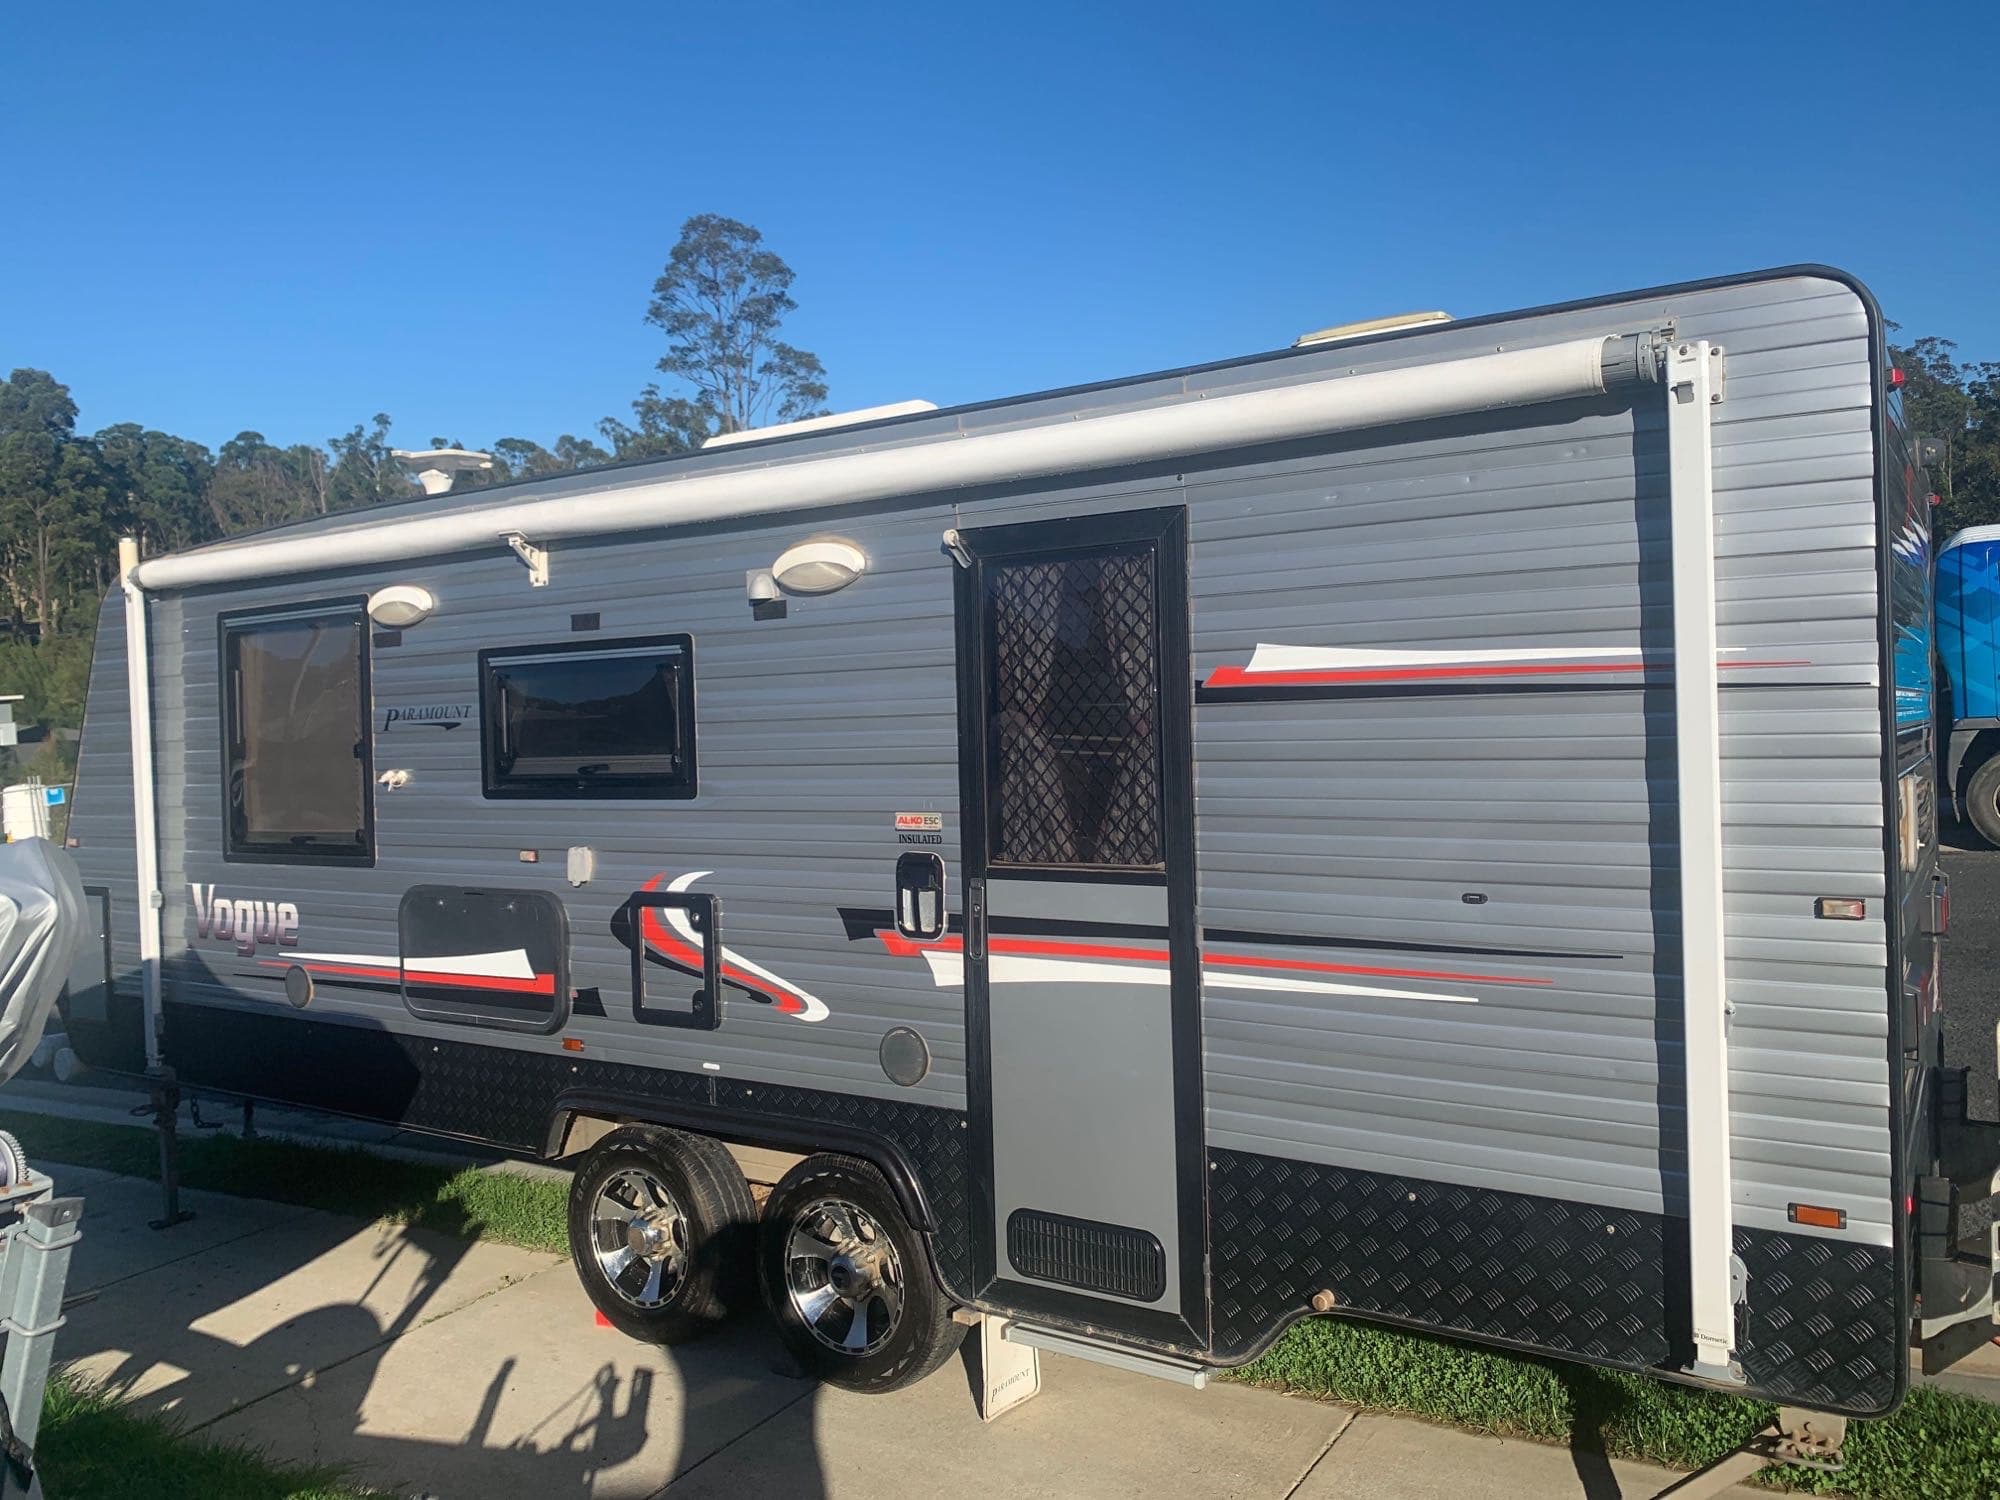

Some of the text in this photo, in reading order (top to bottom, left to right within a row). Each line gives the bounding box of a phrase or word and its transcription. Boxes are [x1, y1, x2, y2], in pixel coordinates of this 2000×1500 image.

[384, 705, 472, 731] PARAMOUNT
[924, 816, 939, 825] ESC
[898, 834, 942, 844] INSULATED
[191, 883, 299, 957] Vogue
